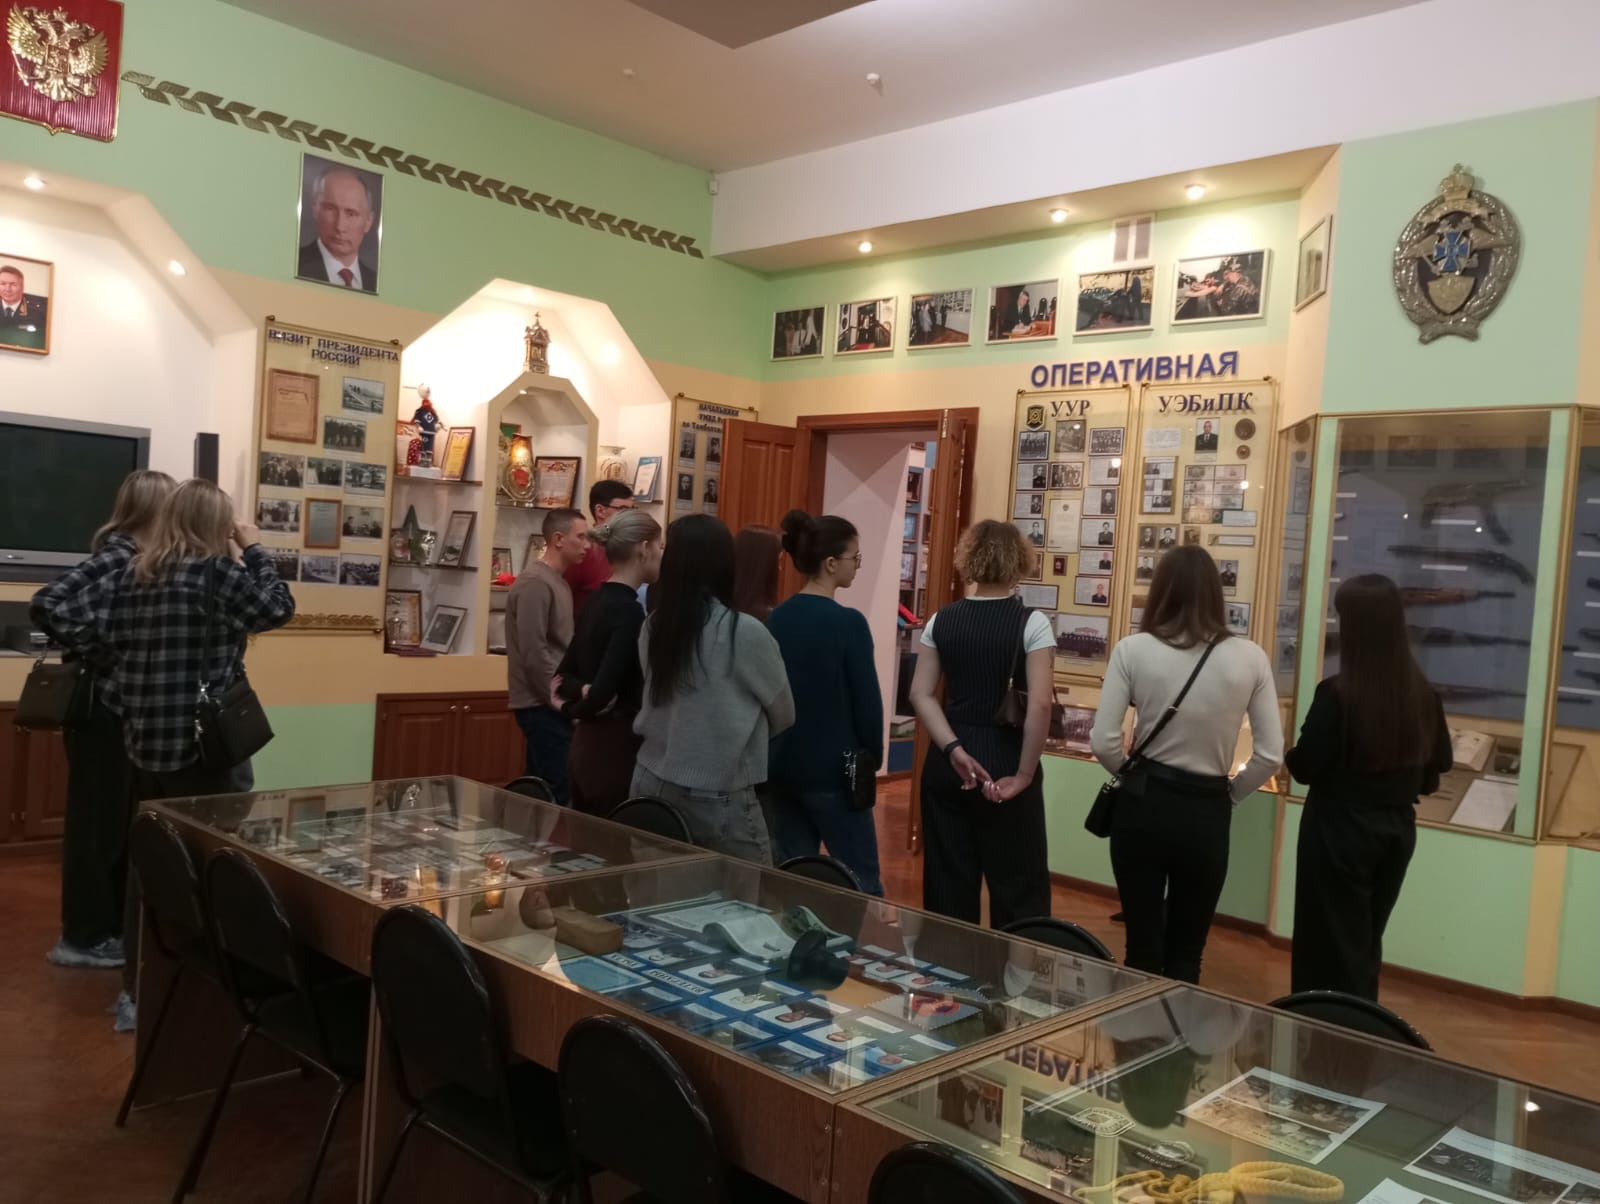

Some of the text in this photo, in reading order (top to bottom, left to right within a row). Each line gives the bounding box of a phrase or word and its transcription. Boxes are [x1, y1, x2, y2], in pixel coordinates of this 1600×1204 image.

[268, 329, 399, 361] ВИЗИТ ПРЕЗИДЕНТА
[311, 348, 360, 365] РОССИИ
[1030, 350, 1239, 388] ОПЕРАТИВНАЯ
[1050, 399, 1091, 418] УУР
[1158, 391, 1253, 414] УЭБиПК
